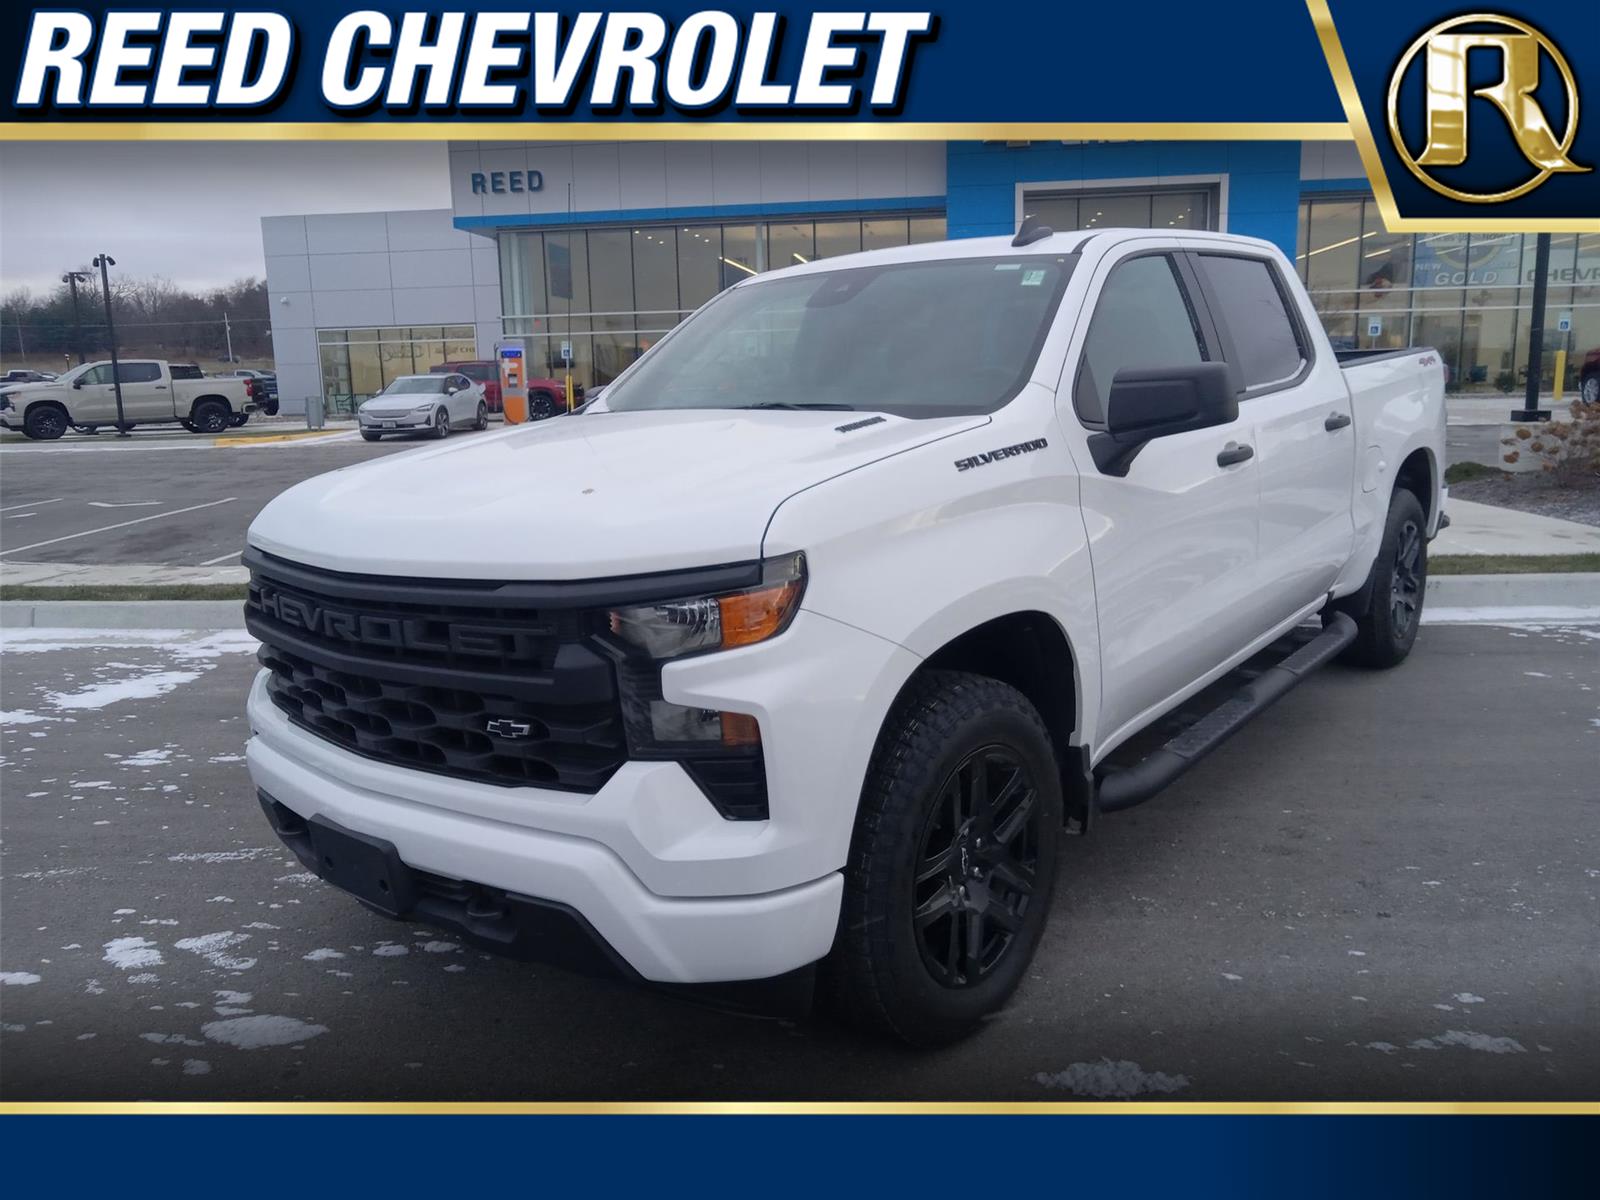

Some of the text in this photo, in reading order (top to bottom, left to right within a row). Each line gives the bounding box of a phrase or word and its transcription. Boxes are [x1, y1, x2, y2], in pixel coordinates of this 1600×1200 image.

[471, 170, 544, 194] REED
[1434, 271, 1498, 285] GOLD
[953, 437, 1049, 472] SILVERADO
[248, 583, 555, 660] CHEVROLET
